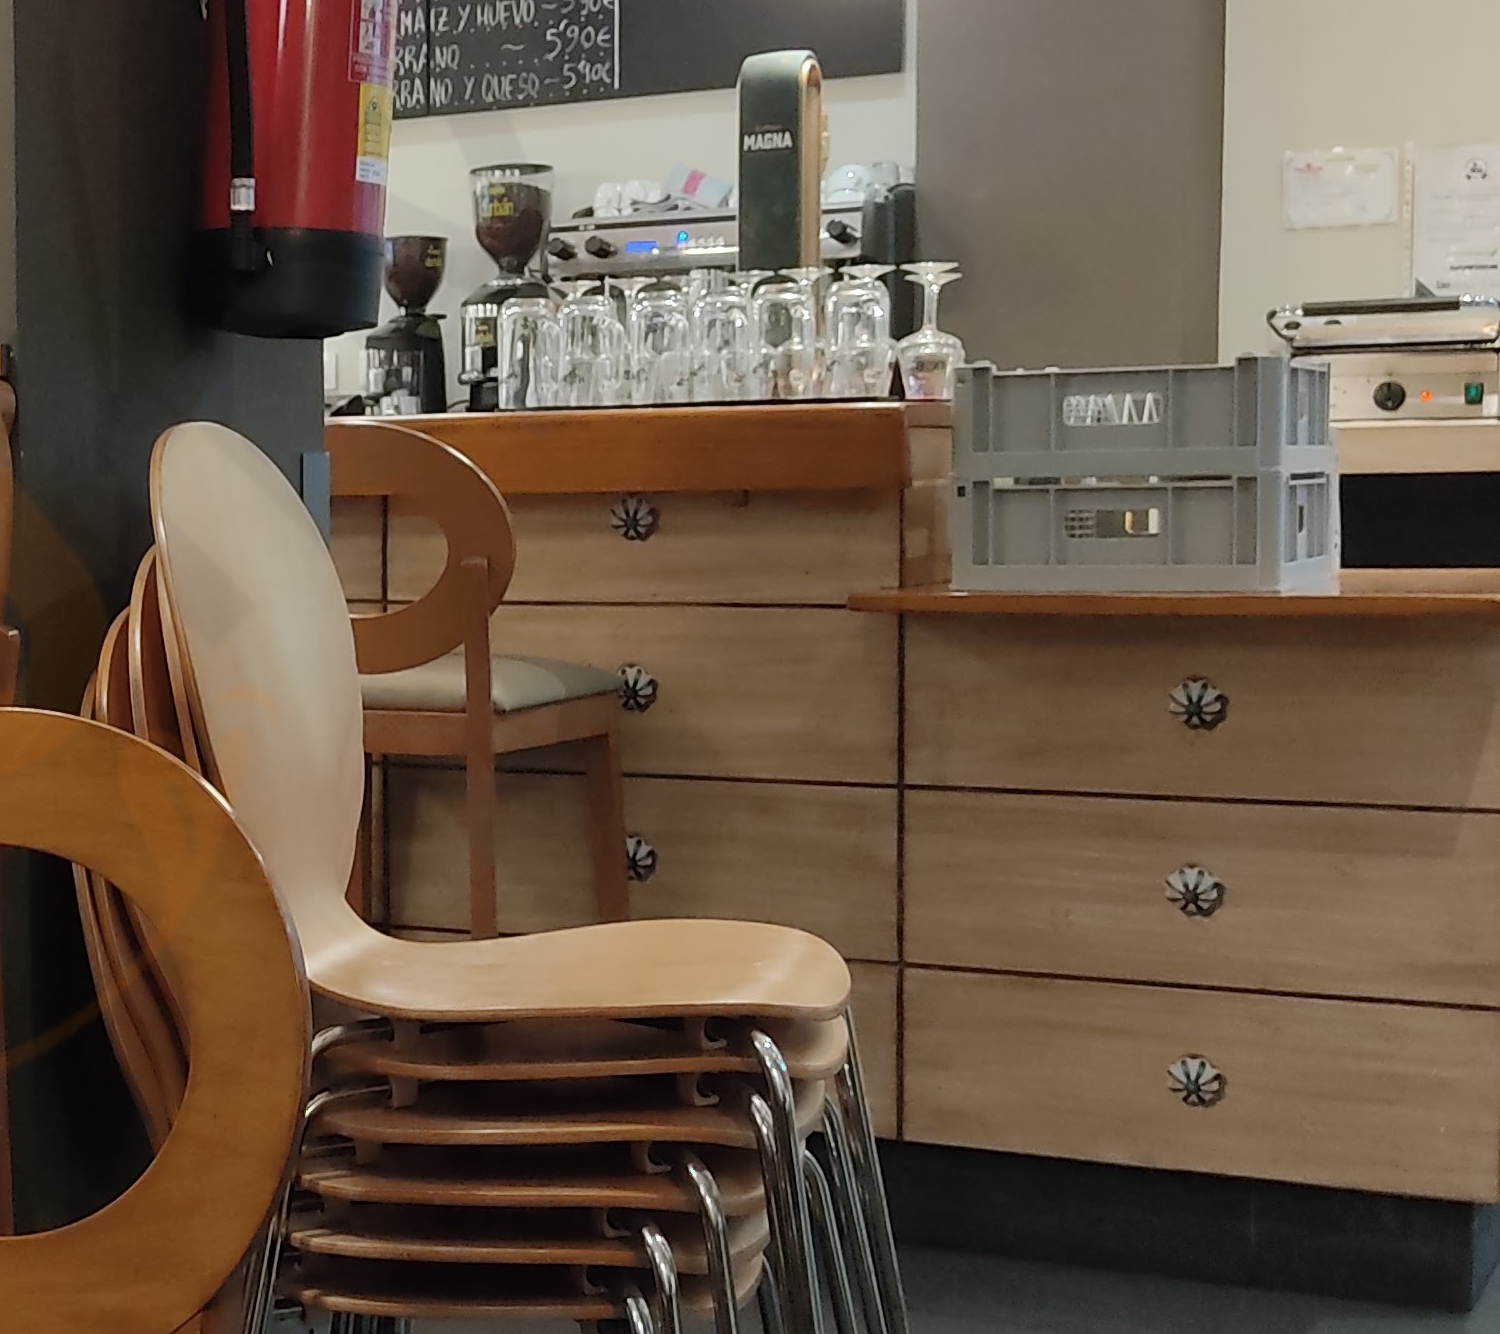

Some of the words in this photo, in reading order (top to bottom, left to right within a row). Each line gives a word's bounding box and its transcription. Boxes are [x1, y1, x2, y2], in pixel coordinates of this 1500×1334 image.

[457, 4, 471, 32] Y
[463, 76, 476, 103] Y
[481, 71, 540, 104] QUESO
[743, 130, 793, 152] MAGNA
